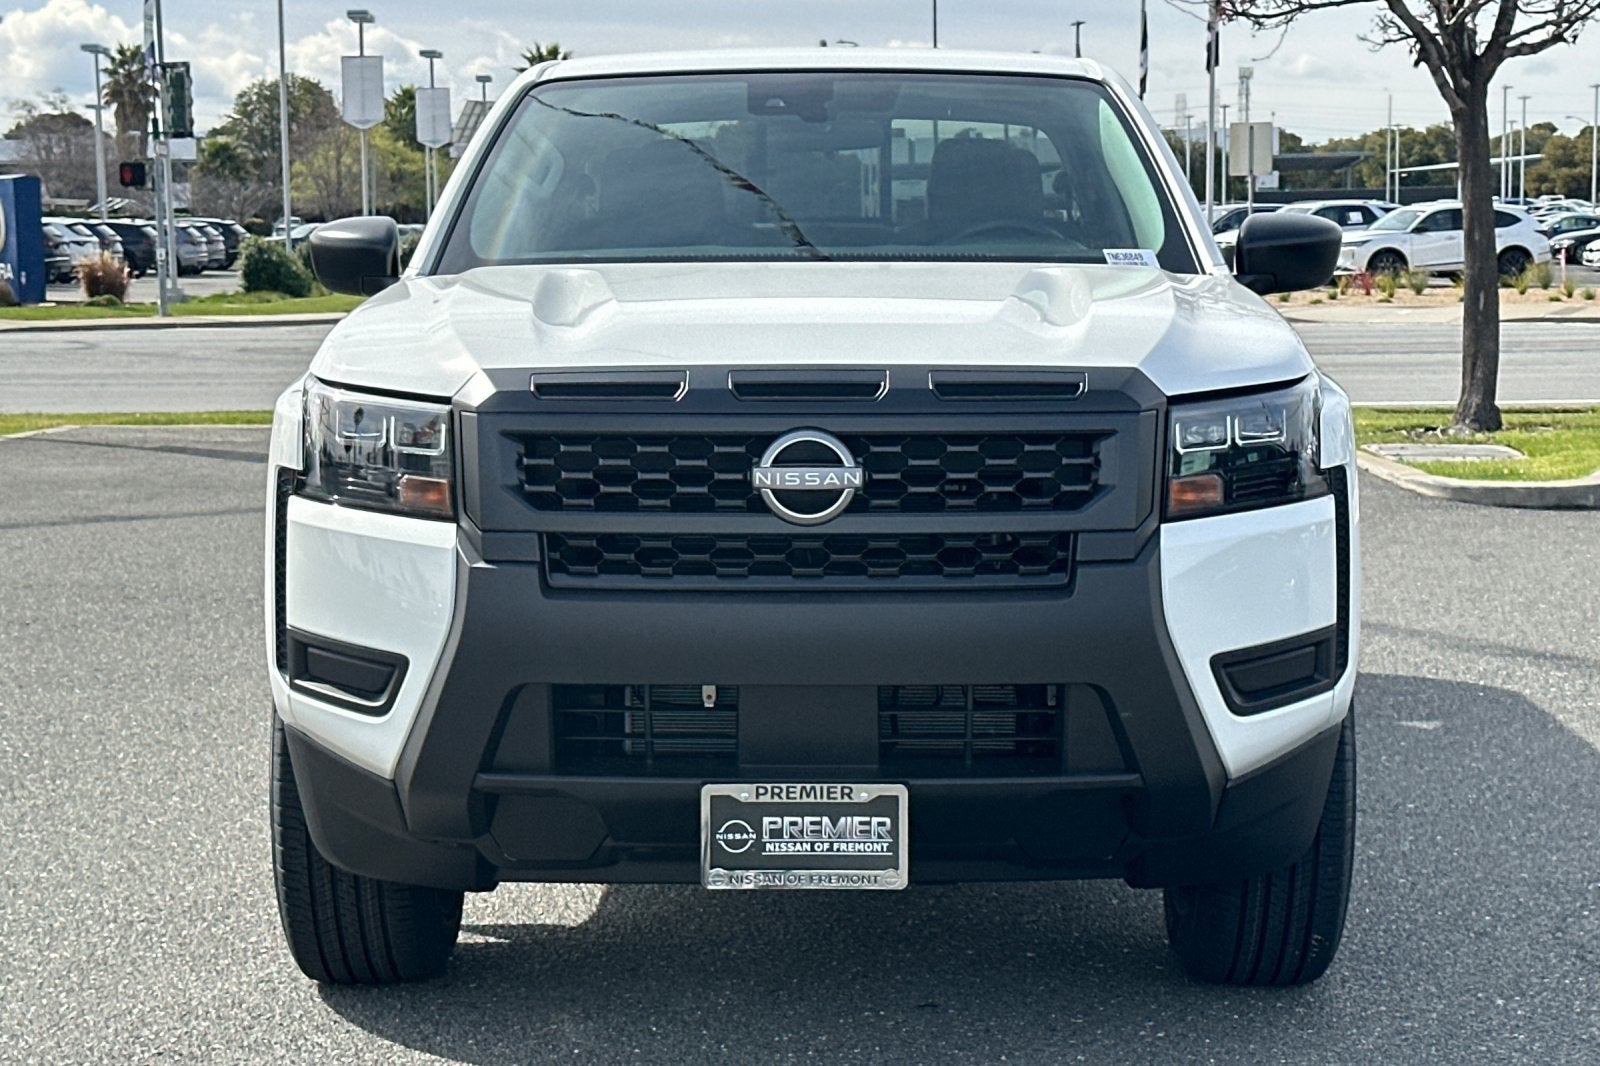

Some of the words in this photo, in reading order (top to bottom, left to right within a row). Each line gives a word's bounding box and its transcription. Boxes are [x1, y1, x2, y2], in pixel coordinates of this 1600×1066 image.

[755, 472, 860, 485] NISSAN
[755, 785, 854, 800] PREMIER
[763, 816, 891, 839] PREMIER
[715, 832, 757, 840] NISSAN
[766, 842, 810, 852] NISSAN
[814, 842, 830, 852] OF
[833, 842, 889, 852] FREMONT
[729, 874, 783, 885] NISSAN
[787, 874, 805, 885] OF
[809, 874, 880, 885] FREMONT
